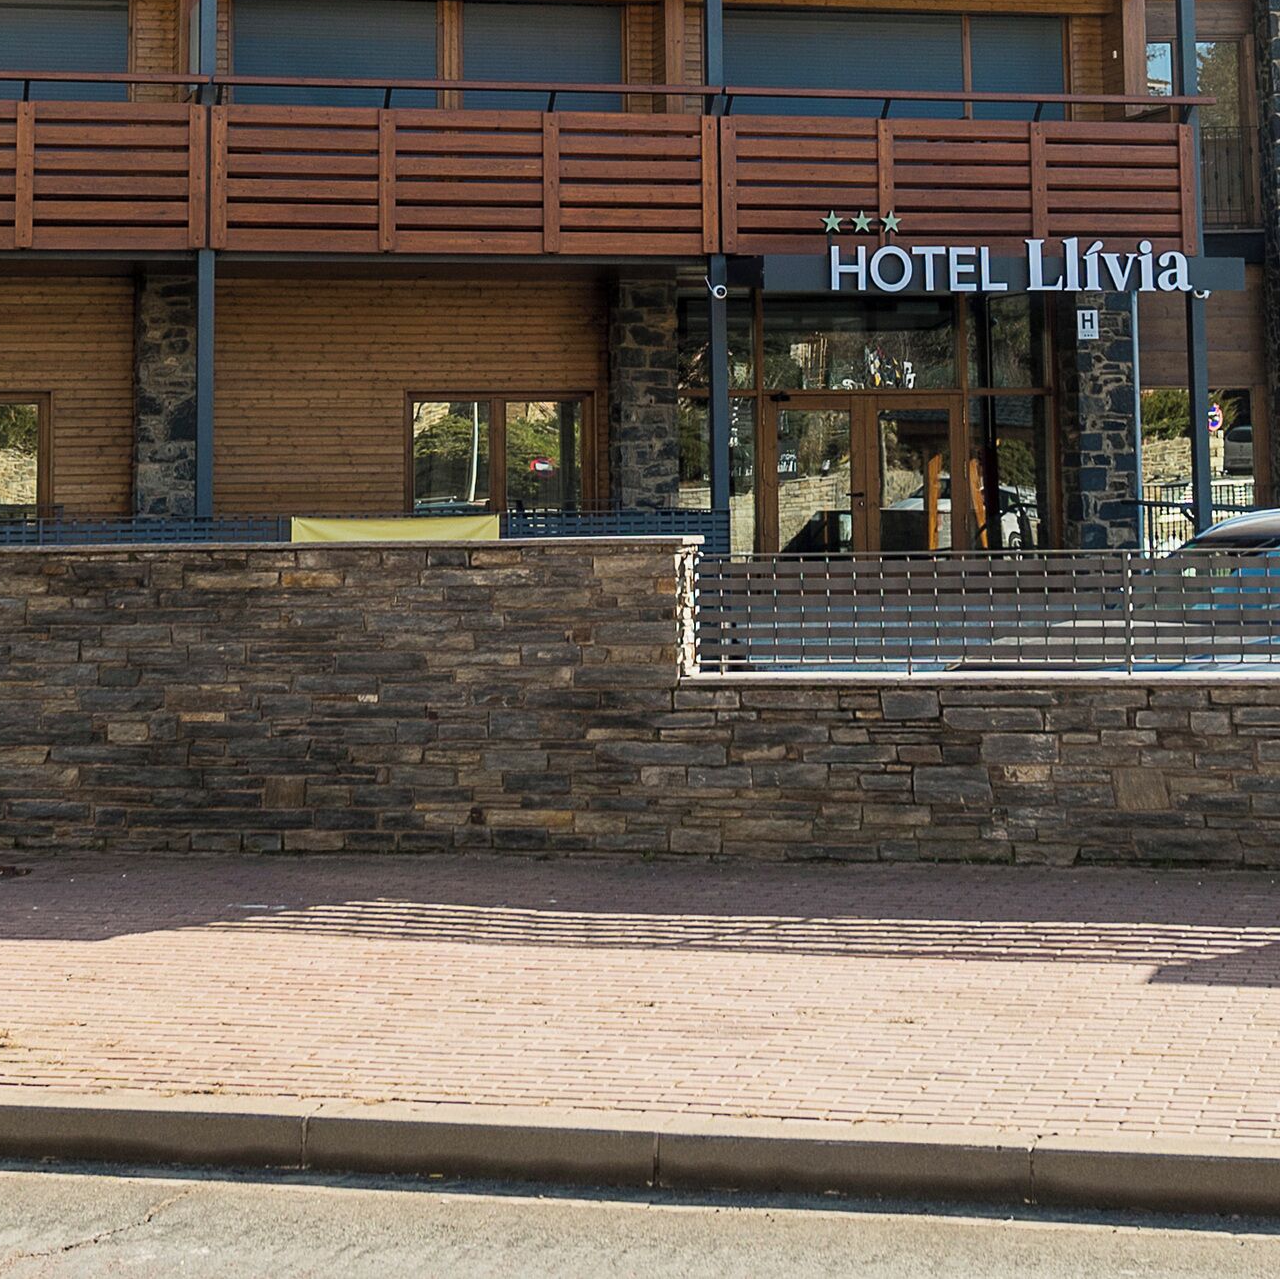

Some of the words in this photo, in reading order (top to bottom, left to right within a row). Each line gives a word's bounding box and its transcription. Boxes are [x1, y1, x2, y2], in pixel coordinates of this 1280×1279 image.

[830, 245, 1008, 292] HOTEL
[1024, 236, 1193, 291] Llívia
[1082, 313, 1094, 329] H
